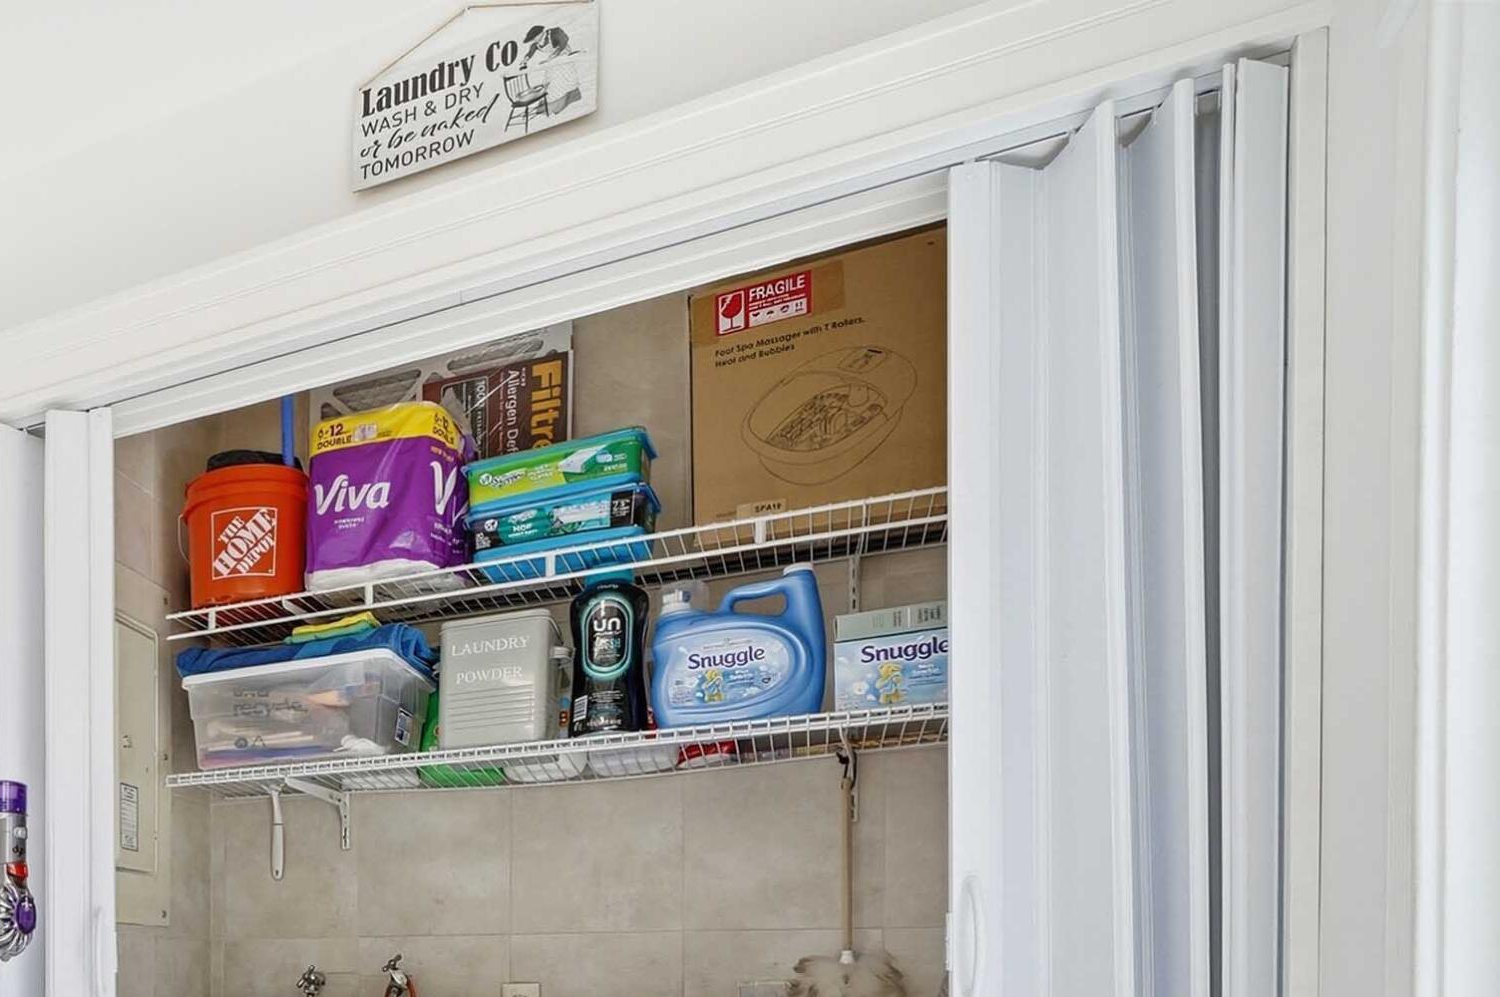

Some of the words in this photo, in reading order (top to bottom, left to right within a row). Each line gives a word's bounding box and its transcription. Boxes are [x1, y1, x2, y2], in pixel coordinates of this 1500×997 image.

[361, 54, 475, 118] Laundry
[485, 40, 519, 73] Co
[360, 138, 382, 160] or
[387, 128, 416, 150] be
[420, 93, 500, 138] naked
[361, 105, 418, 137] WASH
[423, 100, 437, 117] &
[444, 82, 485, 110] DRY
[360, 129, 475, 180] TOMORROW
[748, 274, 806, 301] FRAGILE
[755, 331, 801, 349] Massager
[506, 370, 520, 426] Allergen
[530, 359, 562, 450] Filtre
[314, 473, 392, 517] Viva
[212, 508, 276, 577] HOME
[218, 515, 245, 544] THE
[234, 532, 275, 575] DEPOT
[451, 634, 531, 657] LAUNDRY
[687, 645, 766, 670] Snuggle
[860, 636, 948, 663] Snuggle
[455, 664, 524, 686] POWDER
